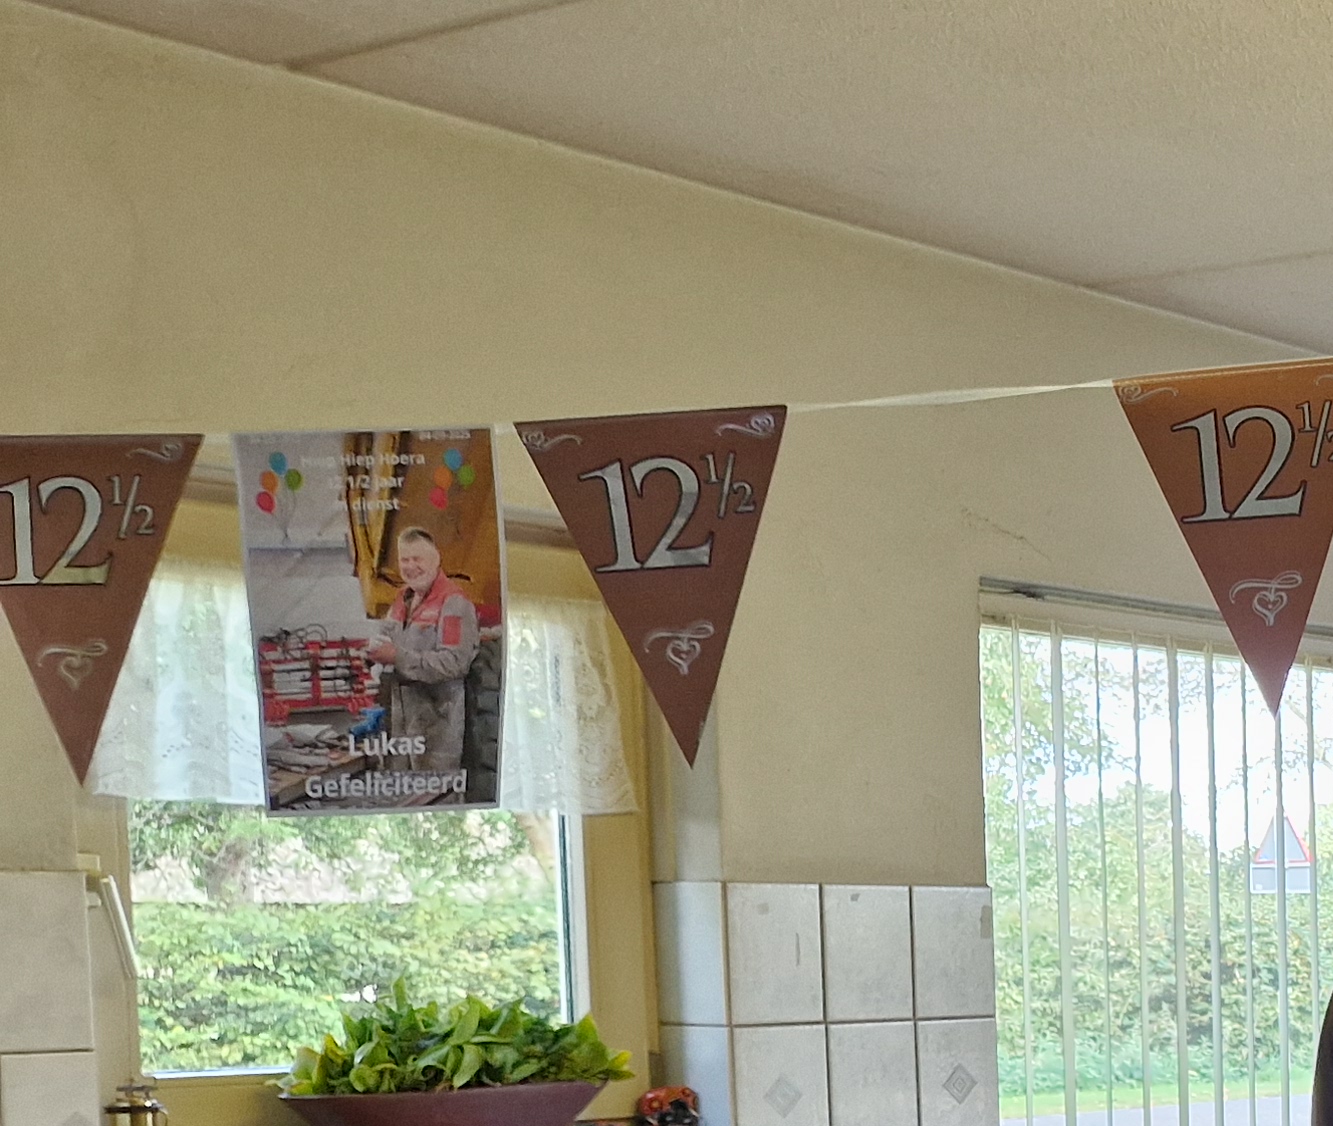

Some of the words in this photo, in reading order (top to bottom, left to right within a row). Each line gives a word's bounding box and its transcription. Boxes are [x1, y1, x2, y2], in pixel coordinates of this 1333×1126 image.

[340, 453, 375, 468] Hiep
[381, 451, 425, 465] Hoera
[1171, 405, 1307, 524] 12
[375, 475, 405, 490] jaar
[353, 497, 399, 511] dienst
[578, 456, 714, 573] 12
[0, 475, 113, 586] 12
[349, 731, 426, 756] Lukas
[305, 769, 467, 798] Gefeliciteerd
